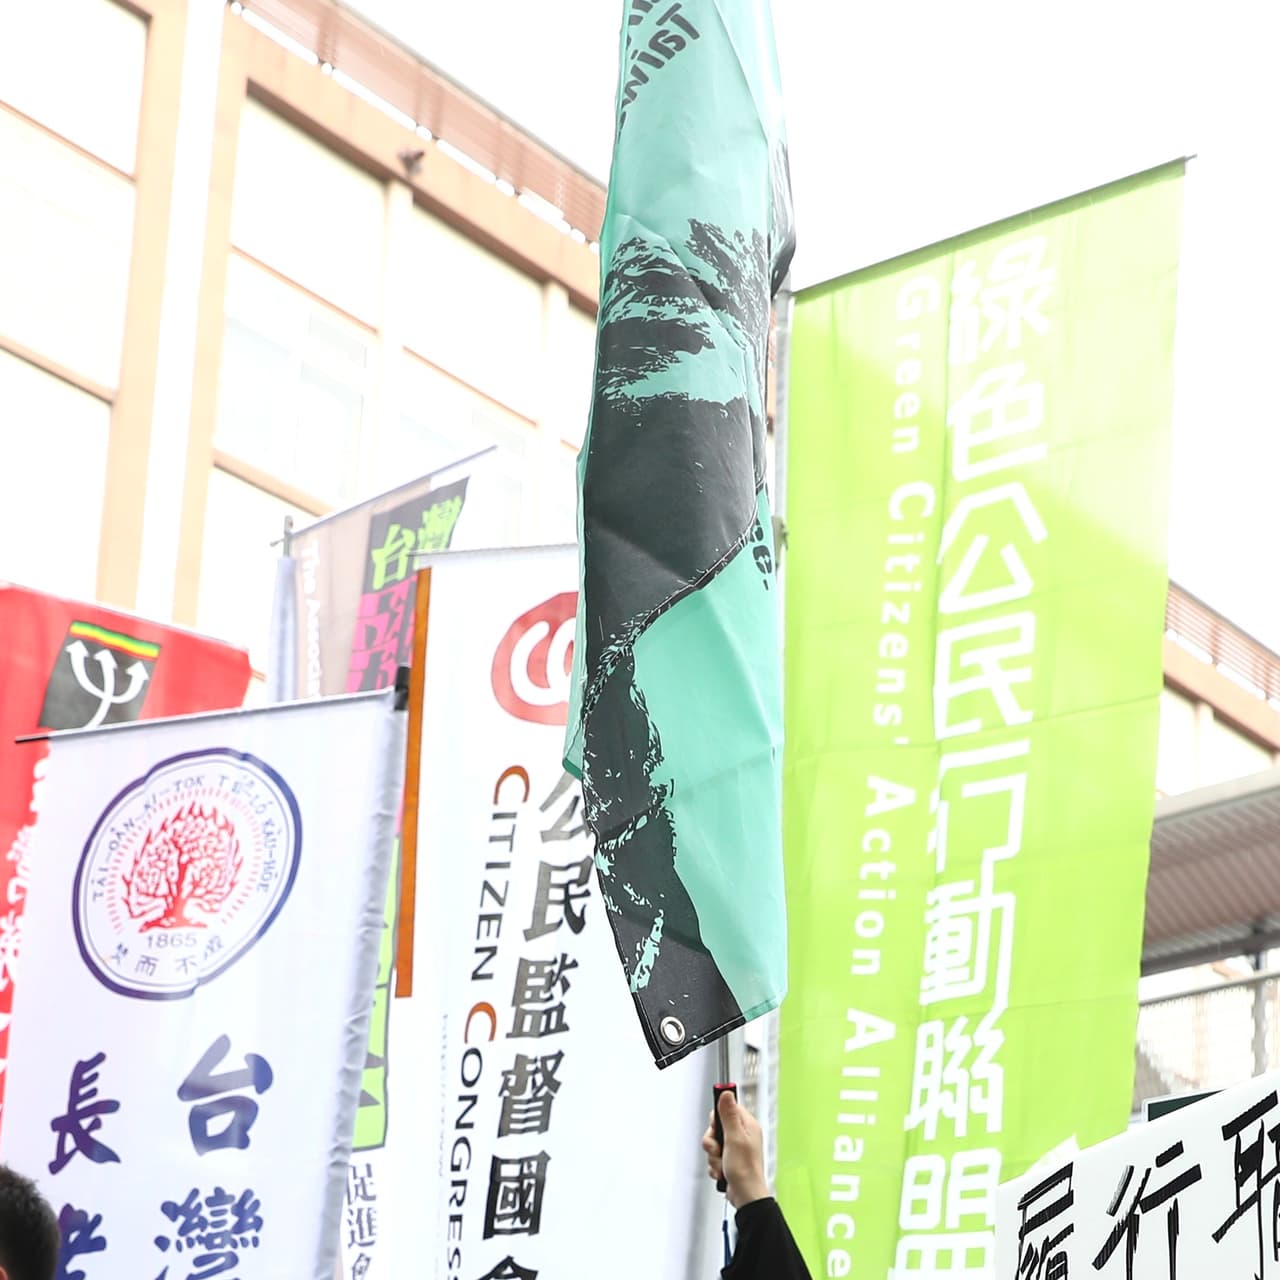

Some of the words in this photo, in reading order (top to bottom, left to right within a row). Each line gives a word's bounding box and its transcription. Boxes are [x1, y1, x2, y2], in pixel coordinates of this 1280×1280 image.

[891, 274, 941, 453] Green
[873, 481, 936, 744] Citizens'
[146, 933, 198, 949] 1865
[471, 764, 530, 981] CITIZEN
[851, 776, 917, 976] Action
[827, 1008, 897, 1279] Alliance
